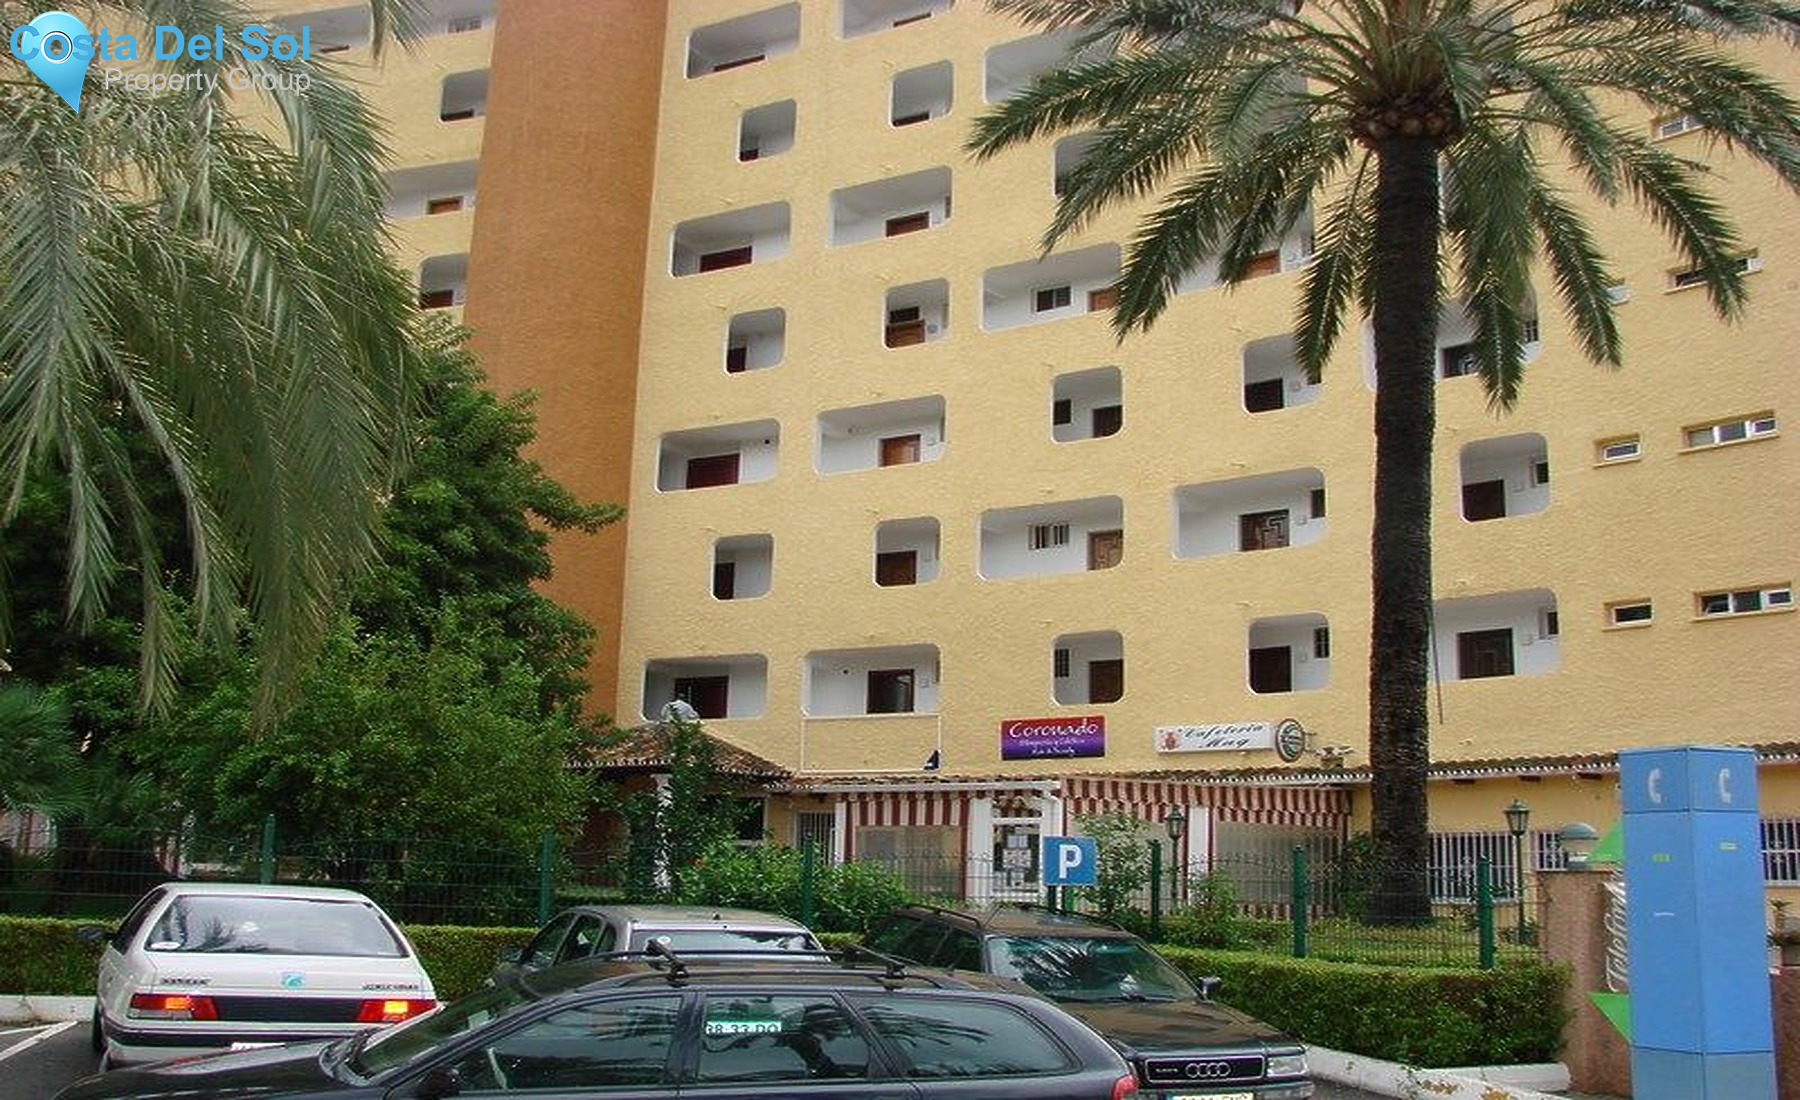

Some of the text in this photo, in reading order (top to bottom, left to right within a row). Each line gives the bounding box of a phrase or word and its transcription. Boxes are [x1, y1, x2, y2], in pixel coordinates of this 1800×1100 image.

[1009, 717, 1098, 738] Coronado
[1181, 721, 1263, 739] Cafeteria
[1059, 844, 1082, 879] P
